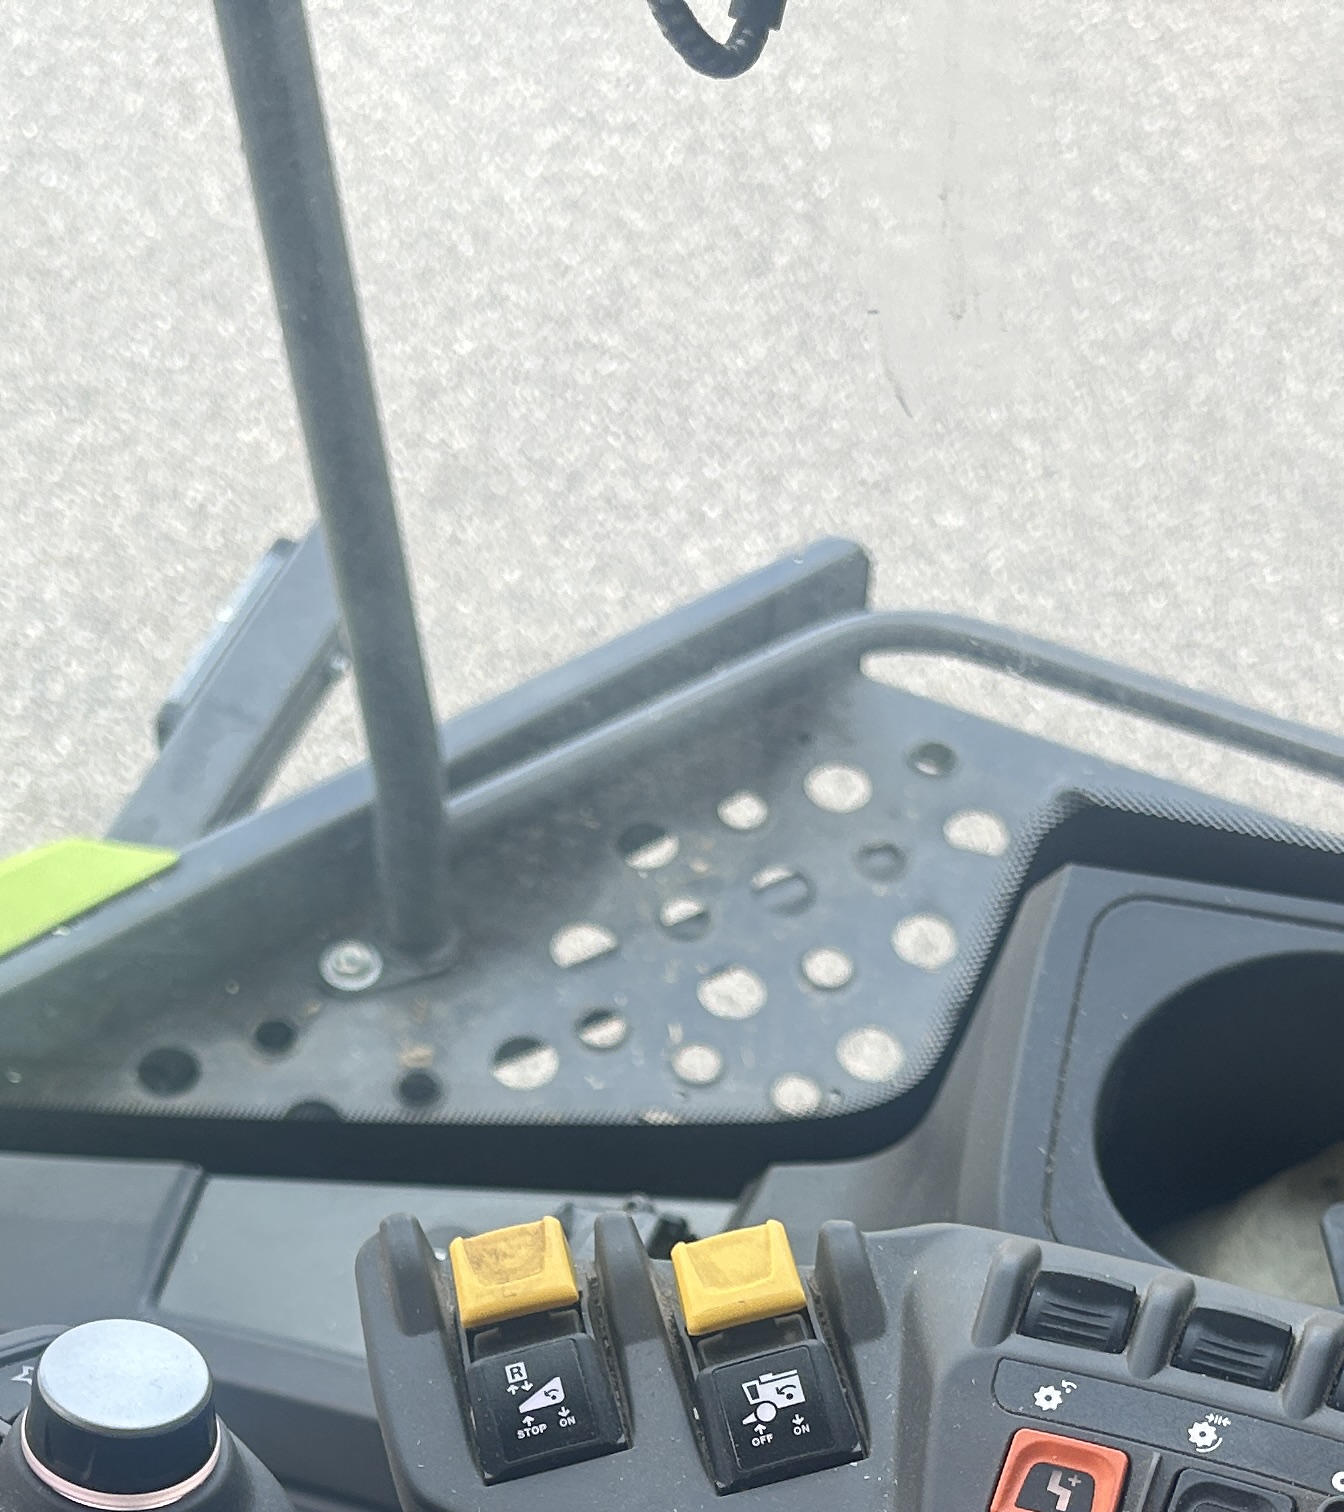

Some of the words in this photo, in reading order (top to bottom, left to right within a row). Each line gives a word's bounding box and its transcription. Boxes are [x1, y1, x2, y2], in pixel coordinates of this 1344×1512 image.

[559, 1415, 577, 1428] ON
[517, 1423, 548, 1440] STOP
[793, 1423, 811, 1436] ON
[751, 1433, 774, 1447] OFF
